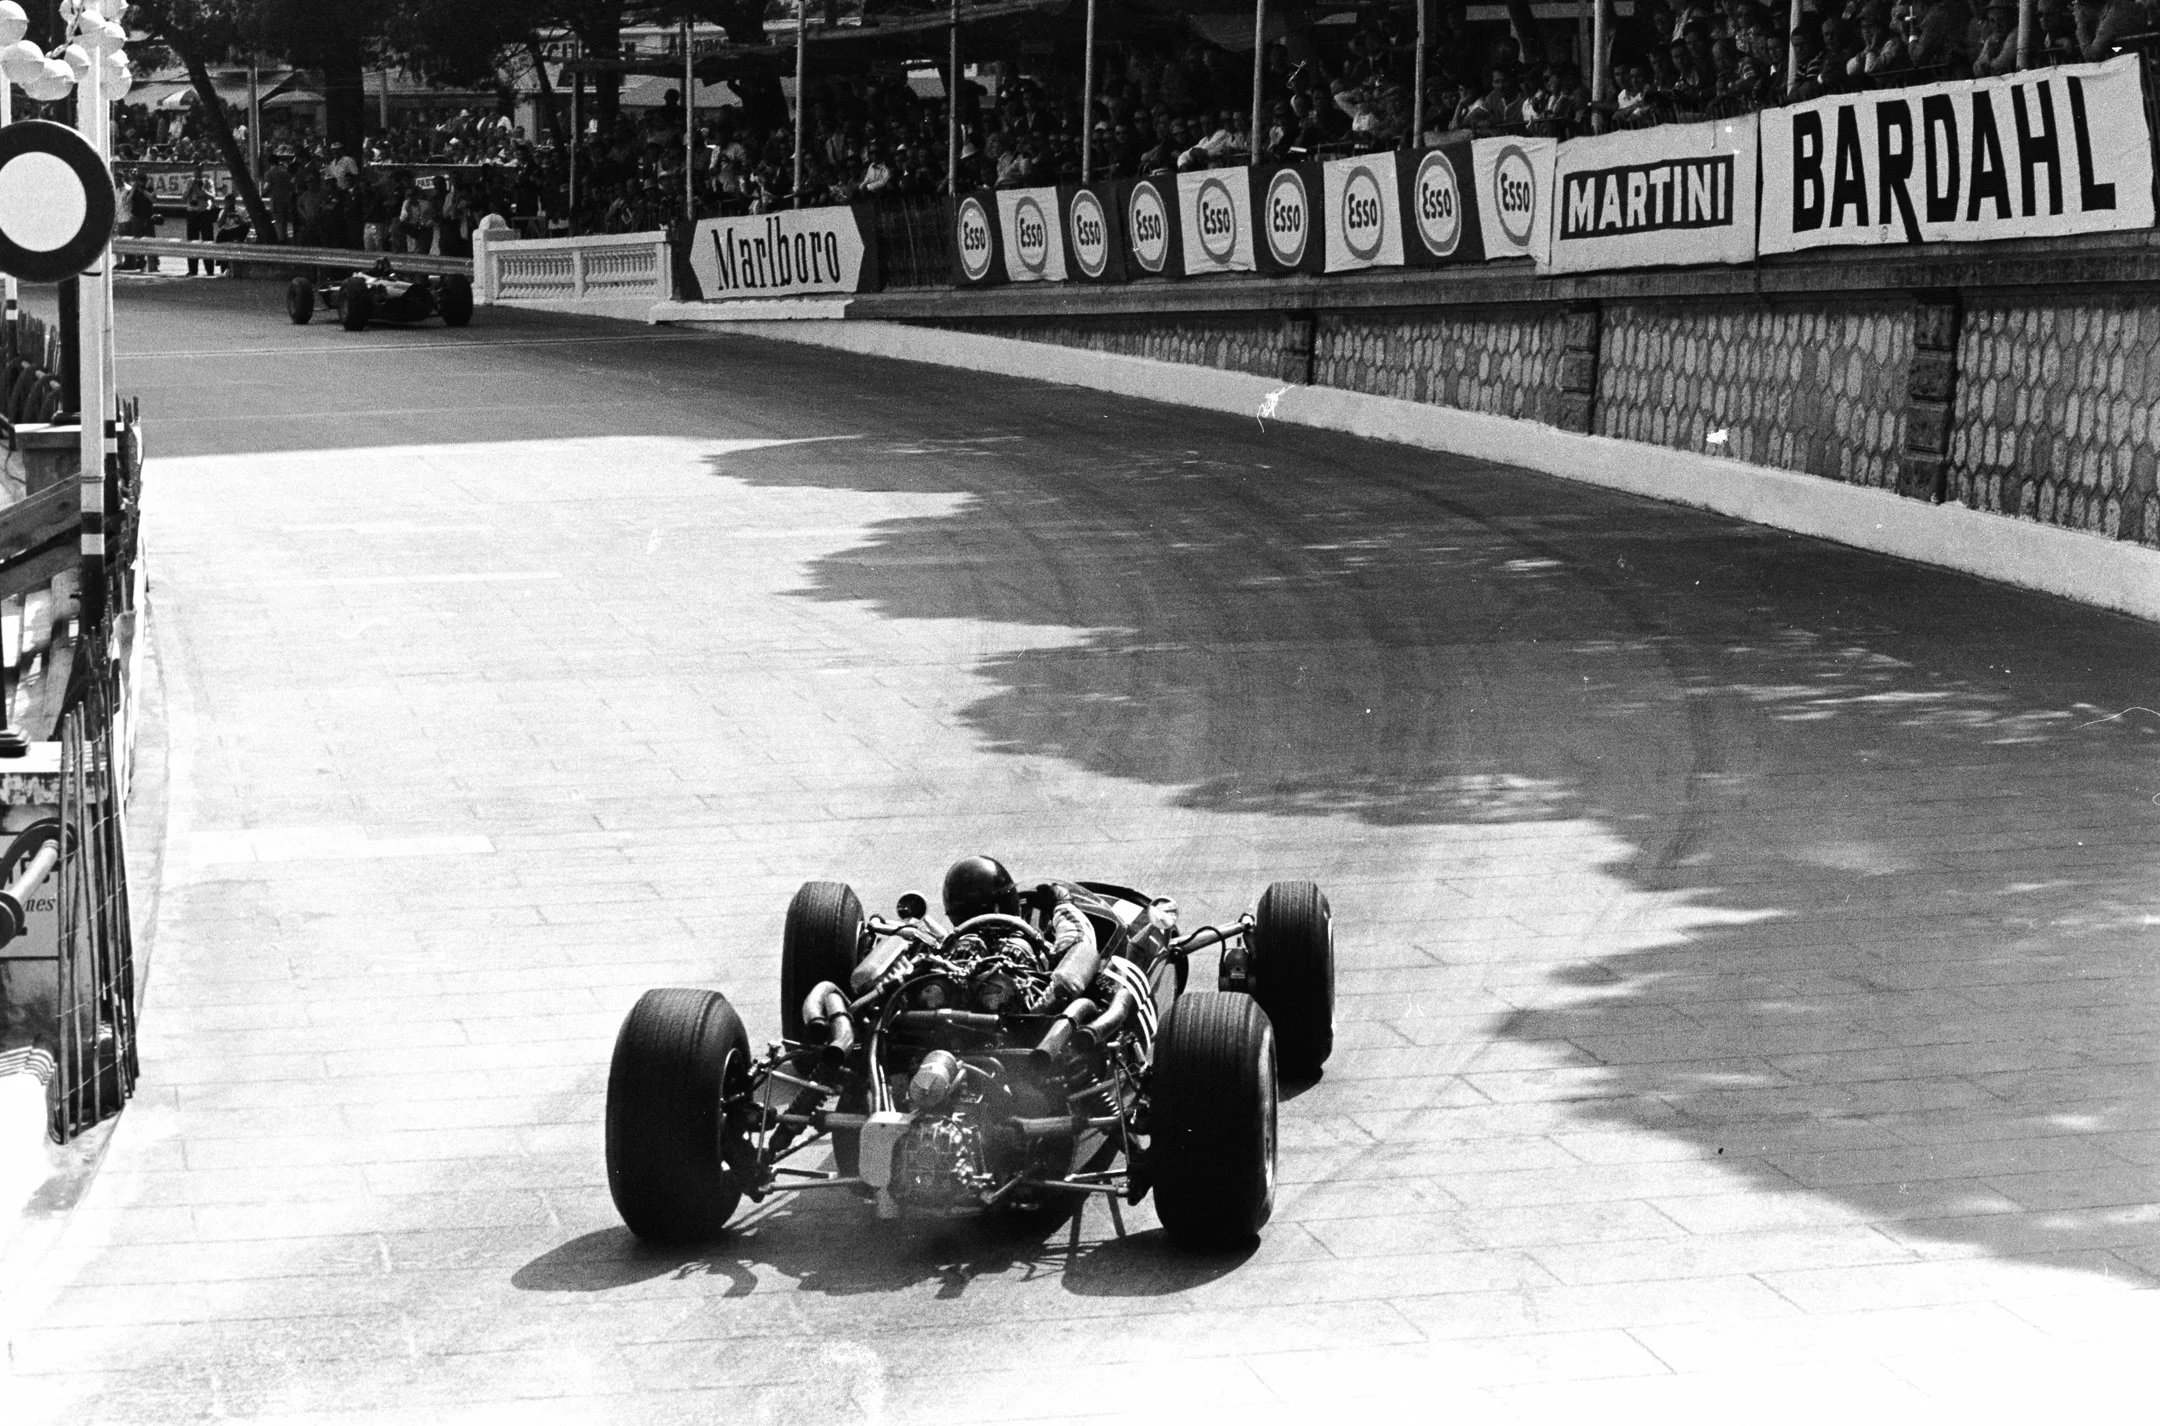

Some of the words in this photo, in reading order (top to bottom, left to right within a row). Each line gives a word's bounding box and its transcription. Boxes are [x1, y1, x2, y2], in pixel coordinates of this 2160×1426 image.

[1793, 76, 2116, 243] BARDAHL
[1569, 163, 1725, 232] MARTINI
[711, 216, 840, 290] Marlboro
